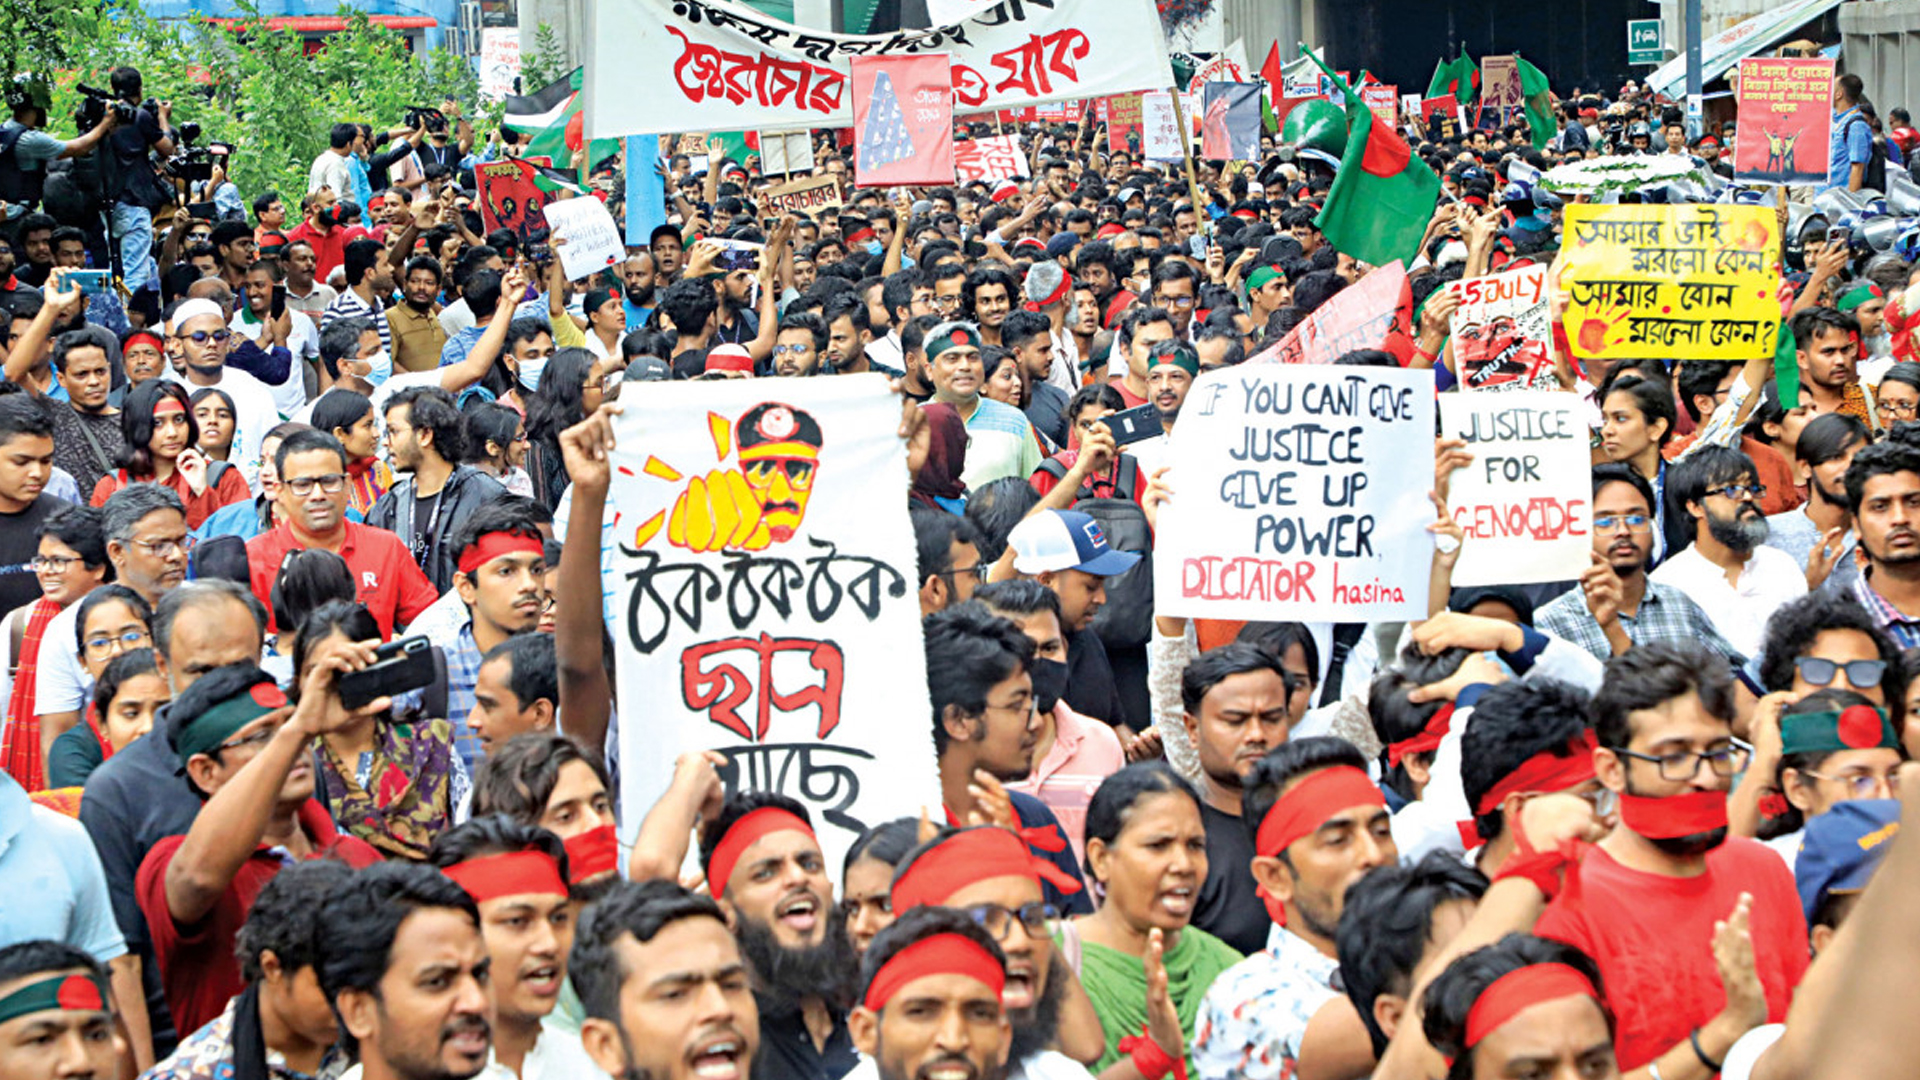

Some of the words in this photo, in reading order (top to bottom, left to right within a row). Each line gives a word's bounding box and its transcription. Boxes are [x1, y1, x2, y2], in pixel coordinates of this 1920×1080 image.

[665, 25, 849, 114] স্বৈরাচার
[991, 28, 1091, 97] যাক
[1575, 219, 1663, 245] আমার
[1676, 209, 1724, 245] ভাই
[1631, 248, 1707, 275] মরলো
[1484, 271, 1544, 304] JULY
[1572, 280, 1663, 308] আমার
[1679, 282, 1739, 310] বোন
[1629, 316, 1706, 346] মরলো
[1199, 382, 1228, 416] IF
[1241, 377, 1292, 416] YOU
[1368, 386, 1414, 422] GIVE
[1229, 423, 1366, 466] JUSTICE
[1459, 409, 1574, 444] JUSTICE
[1485, 455, 1541, 484] FOR
[1220, 470, 1298, 510] GIVE
[1322, 472, 1369, 508] UP
[1455, 497, 1588, 541] GENOCIDE
[362, 571, 378, 588] R
[1181, 556, 1317, 604] DICTATOR
[1332, 562, 1406, 606] hasina
[680, 631, 845, 744] ছাত্র
